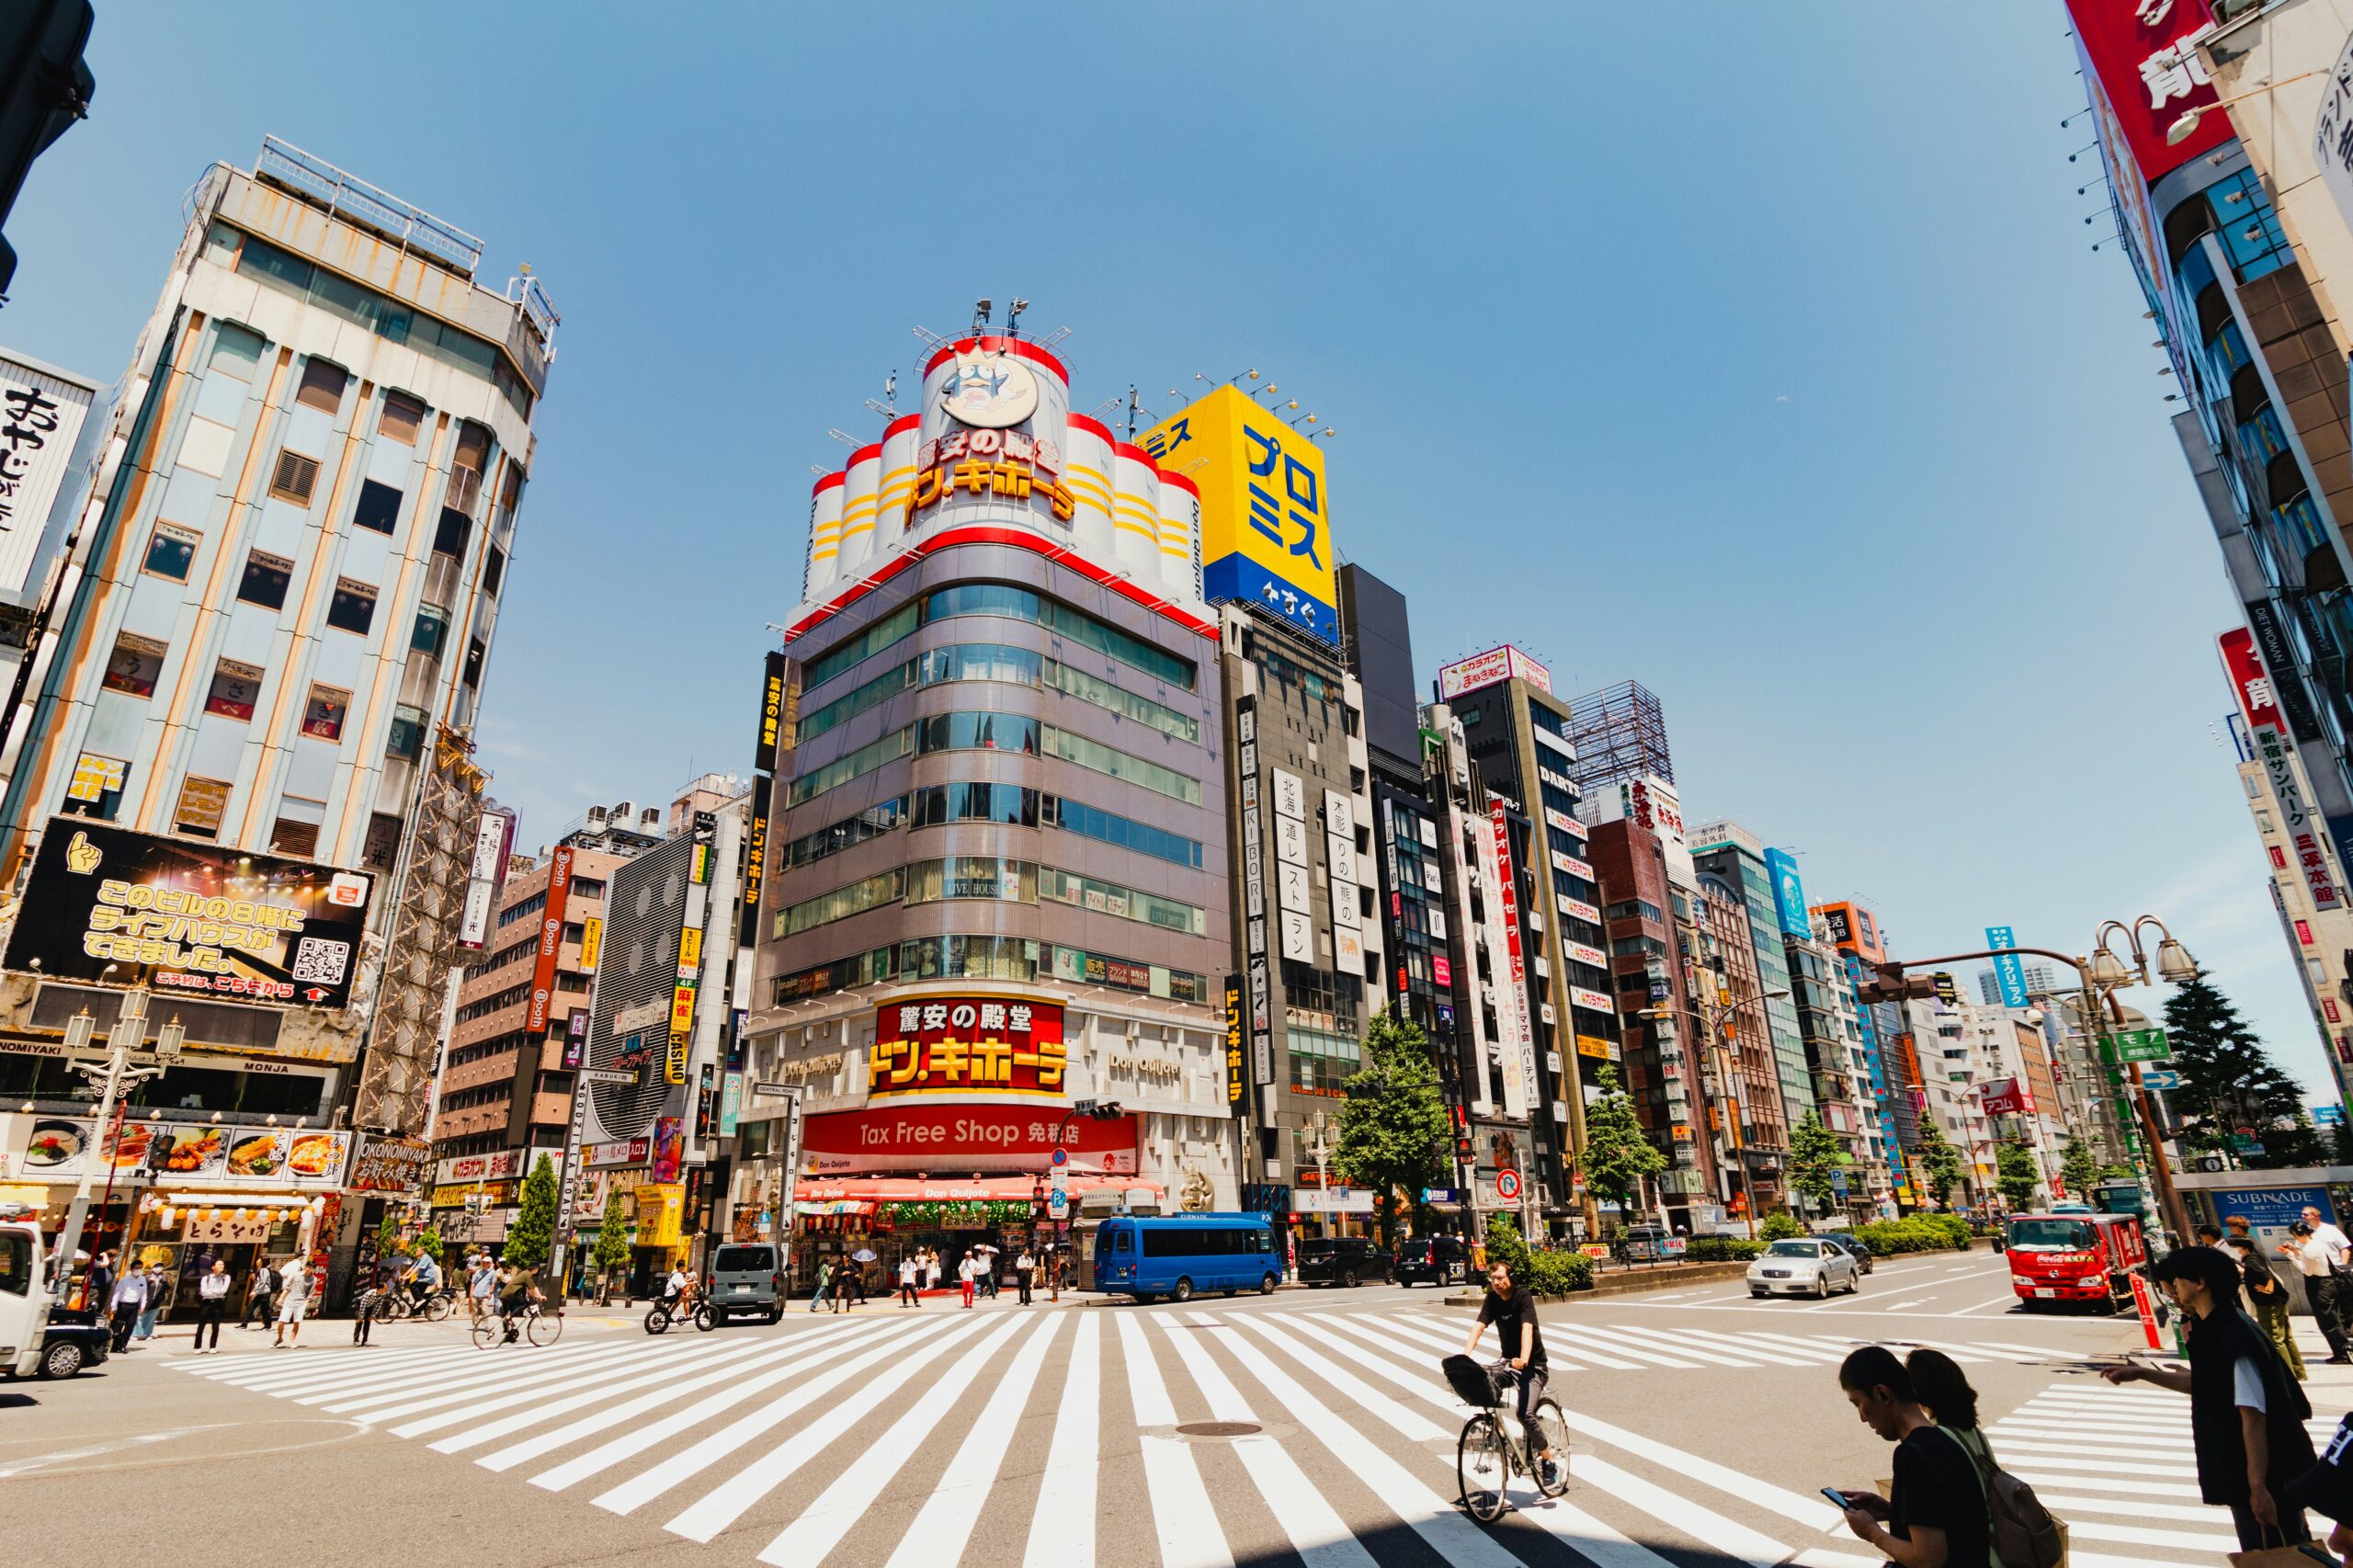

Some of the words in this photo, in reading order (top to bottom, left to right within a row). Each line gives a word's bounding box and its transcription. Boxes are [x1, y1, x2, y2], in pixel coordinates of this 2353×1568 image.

[918, 428, 1060, 475] 驚安の殿堂
[2255, 607, 2268, 626] DIET
[2263, 625, 2285, 663] WOMAN
[1462, 664, 1506, 688] まねきねこ
[1467, 653, 1499, 671] カラオケ
[763, 676, 781, 746] 驚安の殿堂
[1540, 765, 1581, 798] DARTS
[2259, 732, 2304, 826] 新宿サンパーク
[555, 850, 571, 888] Booth
[1245, 811, 1260, 913] KIBORI
[1282, 778, 1305, 955] 北海道レストラン
[1333, 799, 1354, 922] 木彫りの熊の
[1492, 808, 1509, 866] カラオケ
[1502, 881, 1518, 937] パセラ
[2295, 833, 2336, 903] 三平本館
[97, 879, 308, 932] このビルの8階に
[947, 881, 972, 896] LIVE
[973, 881, 1001, 897] HOUSE
[89, 903, 278, 953] ライブハウスが
[544, 918, 560, 957] Booth
[684, 930, 695, 958] 生ビール
[83, 930, 233, 974] できました。
[1086, 958, 1106, 974] 販売
[1108, 965, 1129, 977] ブランド
[532, 988, 549, 1028] Booth
[676, 988, 692, 1017] 麻雀
[899, 1004, 1033, 1034] 驚安の殿堂
[1519, 1015, 1530, 1042] ママ会
[244, 1062, 290, 1074] MONJA
[670, 1033, 685, 1080] CASINO
[1108, 1052, 1132, 1069] Don
[1522, 1047, 1535, 1095] パーティー
[1985, 1099, 2015, 1114] アコム
[567, 1092, 586, 1169] GODZILLA
[861, 1123, 890, 1146] Tax
[896, 1121, 946, 1144] Free
[954, 1119, 1020, 1147] Shop
[1028, 1121, 1080, 1145] 免税店
[324, 1136, 345, 1177] かつ丼
[360, 1142, 430, 1165] OKONOMIYAKI
[457, 1158, 483, 1177] カラオケ
[819, 1161, 830, 1169] Don
[831, 1159, 851, 1169] Quijote
[357, 1160, 418, 1184] お好み焼き
[560, 1176, 574, 1216] ROAD
[925, 1189, 948, 1199] Don
[950, 1188, 991, 1199] Quijote
[2226, 1191, 2314, 1205] SUBNADE
[188, 1221, 272, 1240] とらそば
